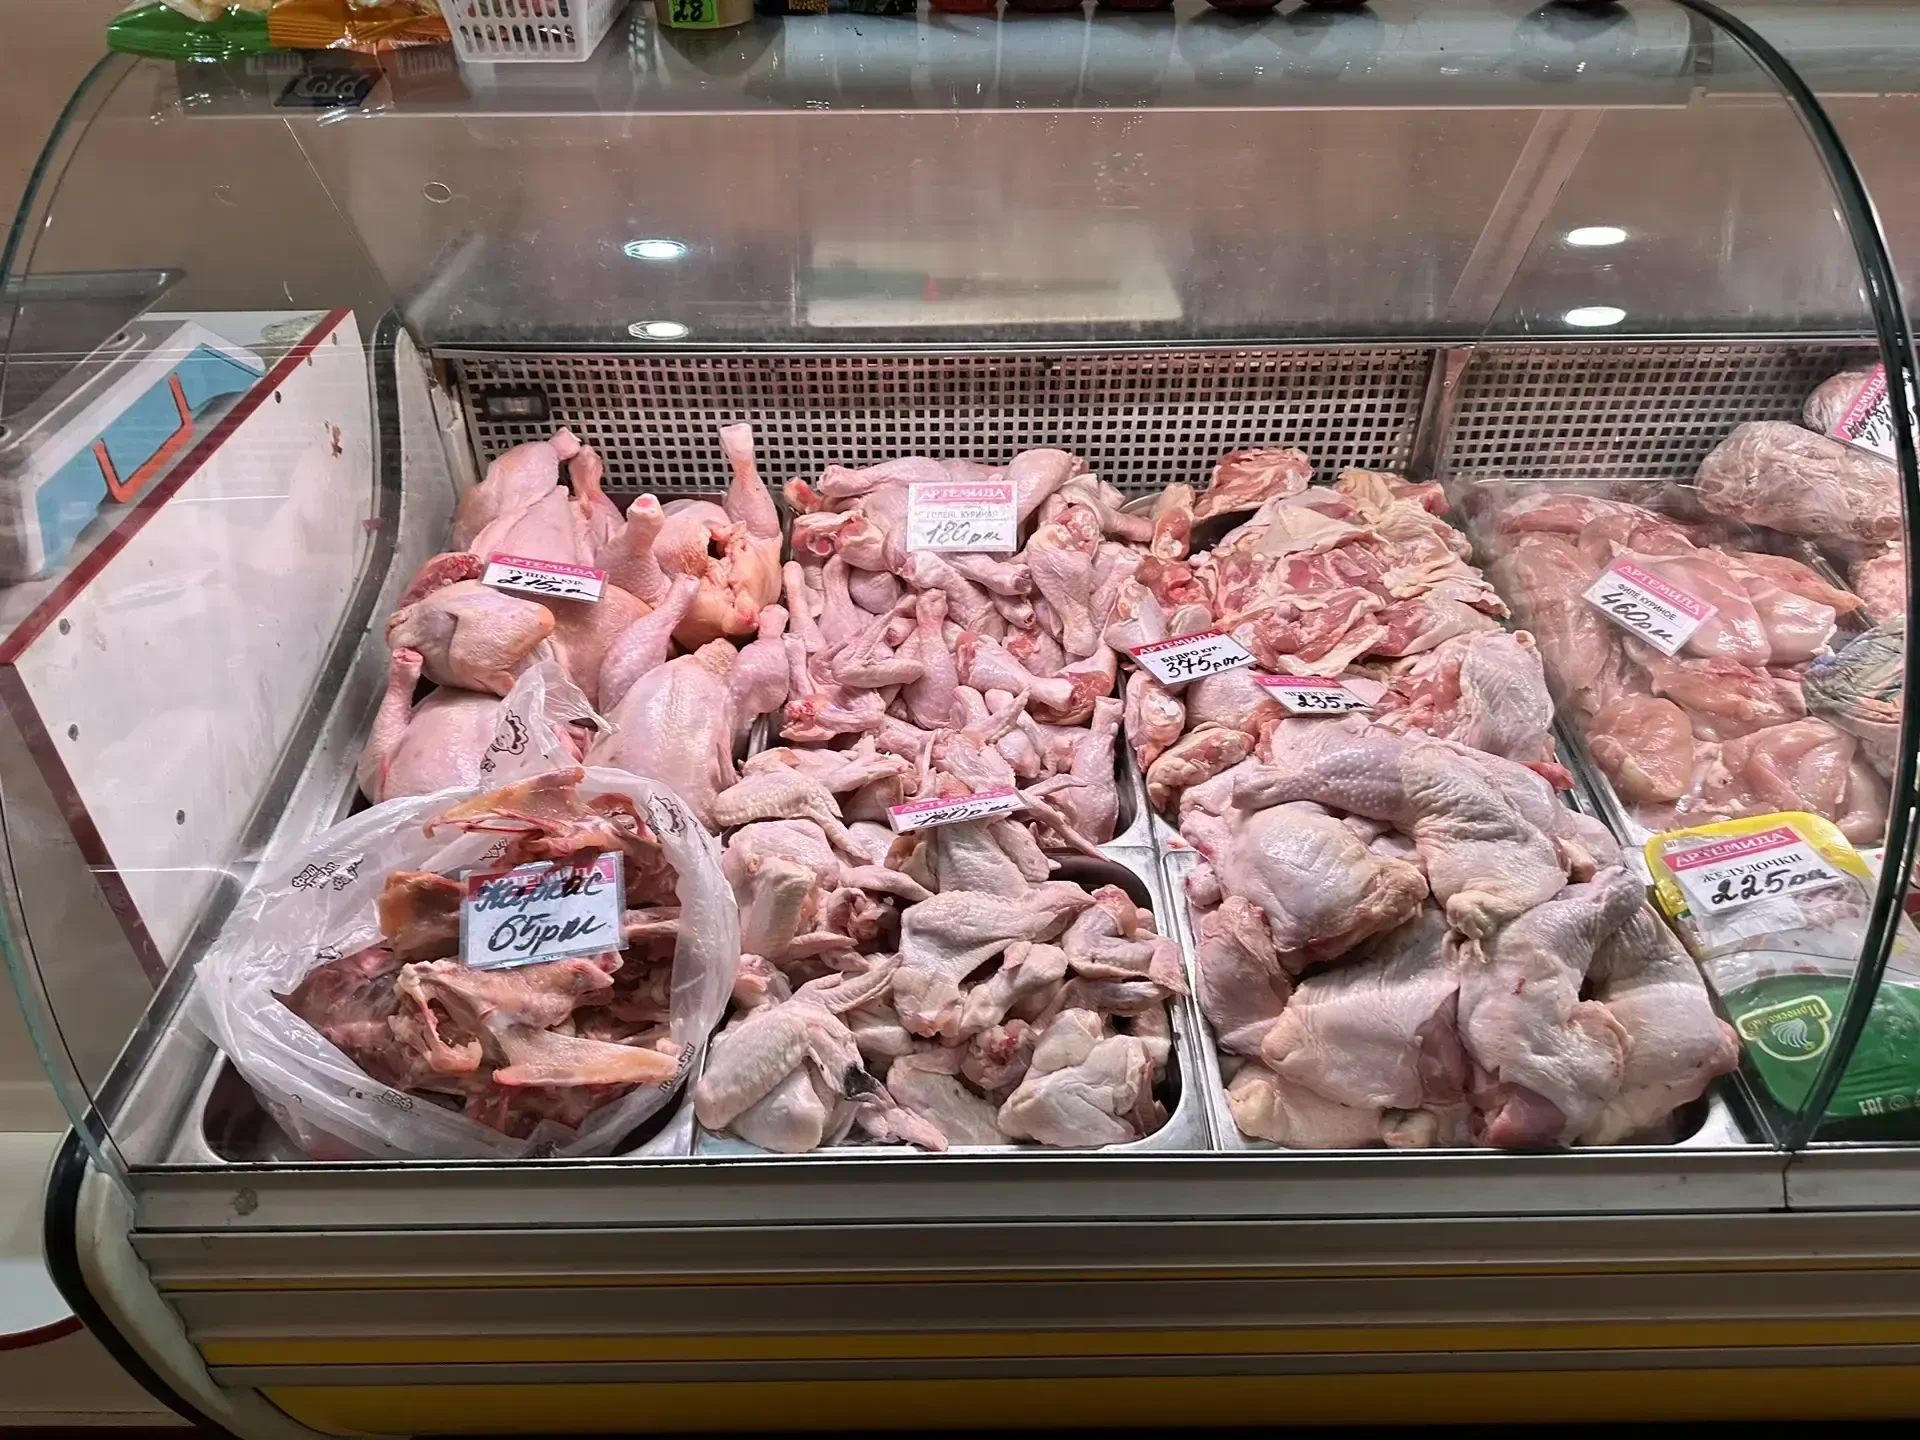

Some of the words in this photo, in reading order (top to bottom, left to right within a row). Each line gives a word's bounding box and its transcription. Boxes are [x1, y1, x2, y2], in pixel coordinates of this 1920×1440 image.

[920, 487, 1006, 501] АРТЕМИДА
[499, 557, 597, 579] АРТЕМИДА
[507, 569, 557, 582] ТУШКА
[1618, 583, 1641, 600] ФИЛЕ
[1640, 596, 1677, 621] КУРИНОЕ
[1619, 565, 1700, 616] АРТЕМИДА
[1139, 631, 1218, 656] АРТЕМИДА
[1160, 650, 1199, 663] БЕДРО
[1676, 831, 1789, 868] АРТЕМИДА
[1702, 853, 1803, 883] ЖЕЛУДОЧКИ
